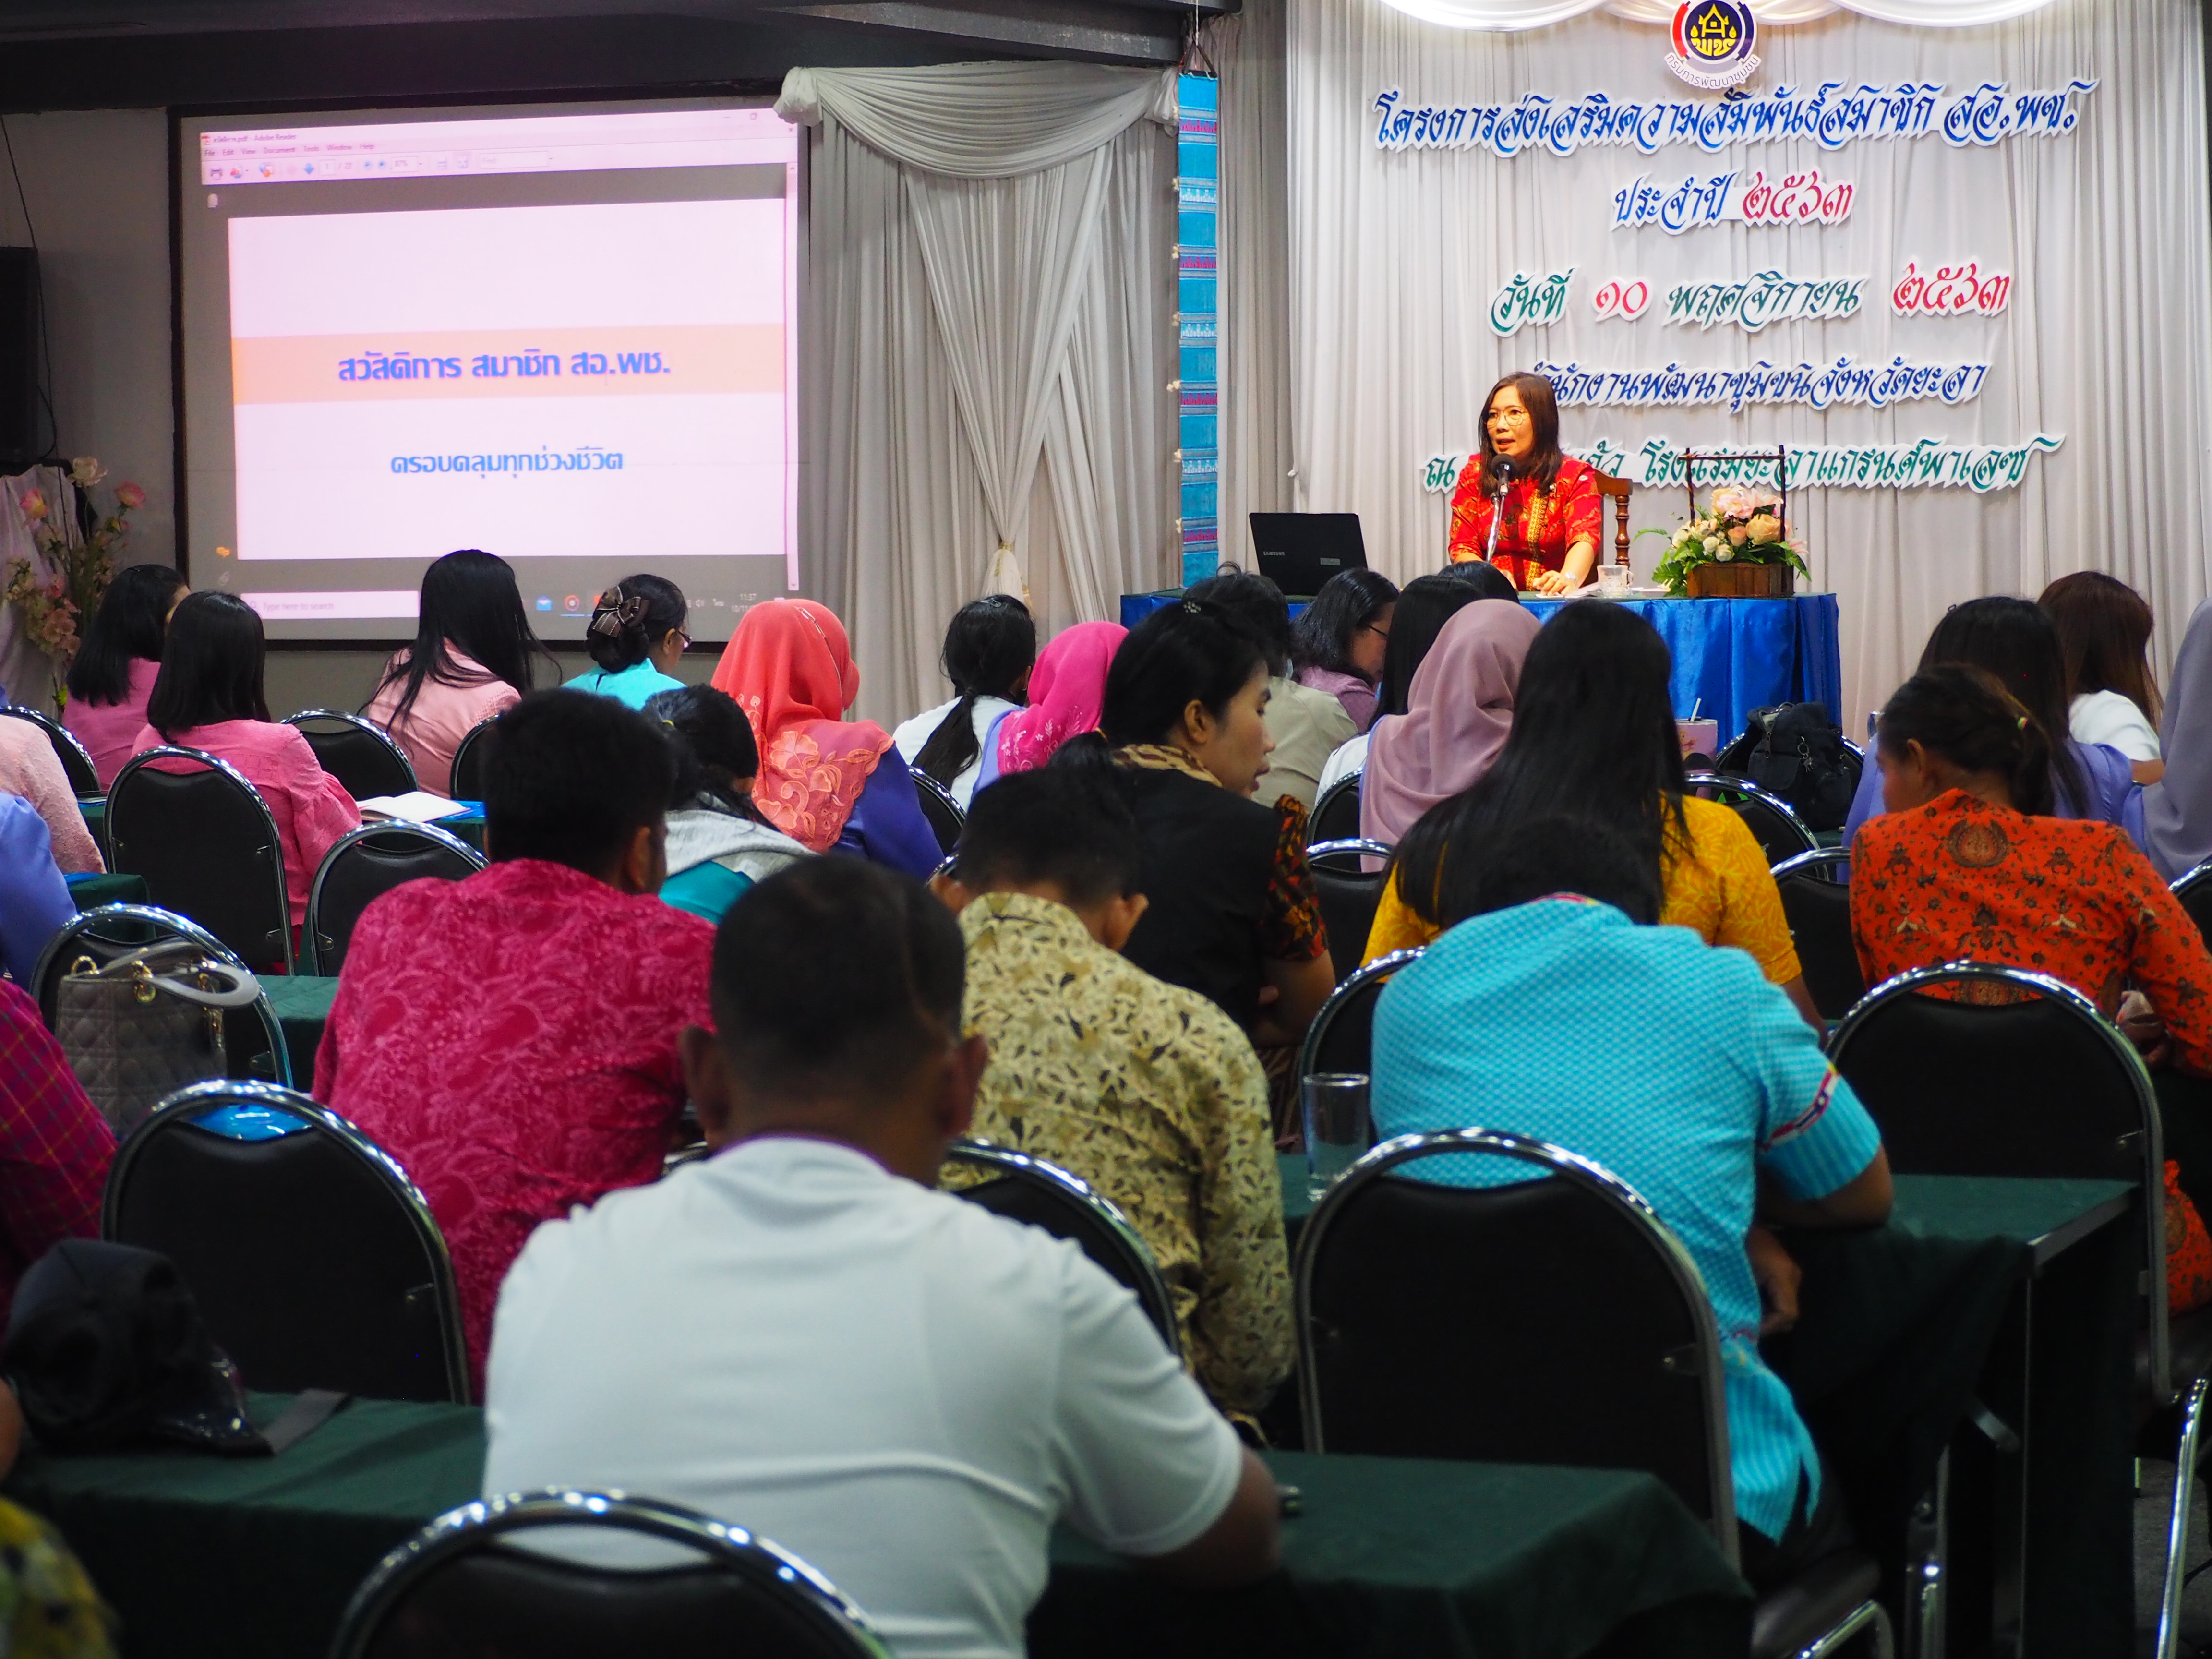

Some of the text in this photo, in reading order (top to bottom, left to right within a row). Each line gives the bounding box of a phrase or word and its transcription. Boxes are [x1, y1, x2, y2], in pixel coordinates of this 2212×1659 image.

[1666, 54, 1758, 87] กรมการพัฒนาชุมชน
[1376, 81, 1946, 153] โครงการส่งเสริมความสัมพันธ์สมาชิก
[1614, 171, 1852, 230] ประจำปี ๒๕๖๓
[1491, 263, 2010, 332] วันที่ ๑๐ พฤศจิกายน ๒๕๖๓
[338, 349, 671, 381] สวัสดิการ สมาชิก สอ.พช.
[391, 445, 623, 479] ครอบคลุมทุกช่วงชีวิต
[1426, 455, 1457, 488] ณ
[264, 602, 280, 612] Type
